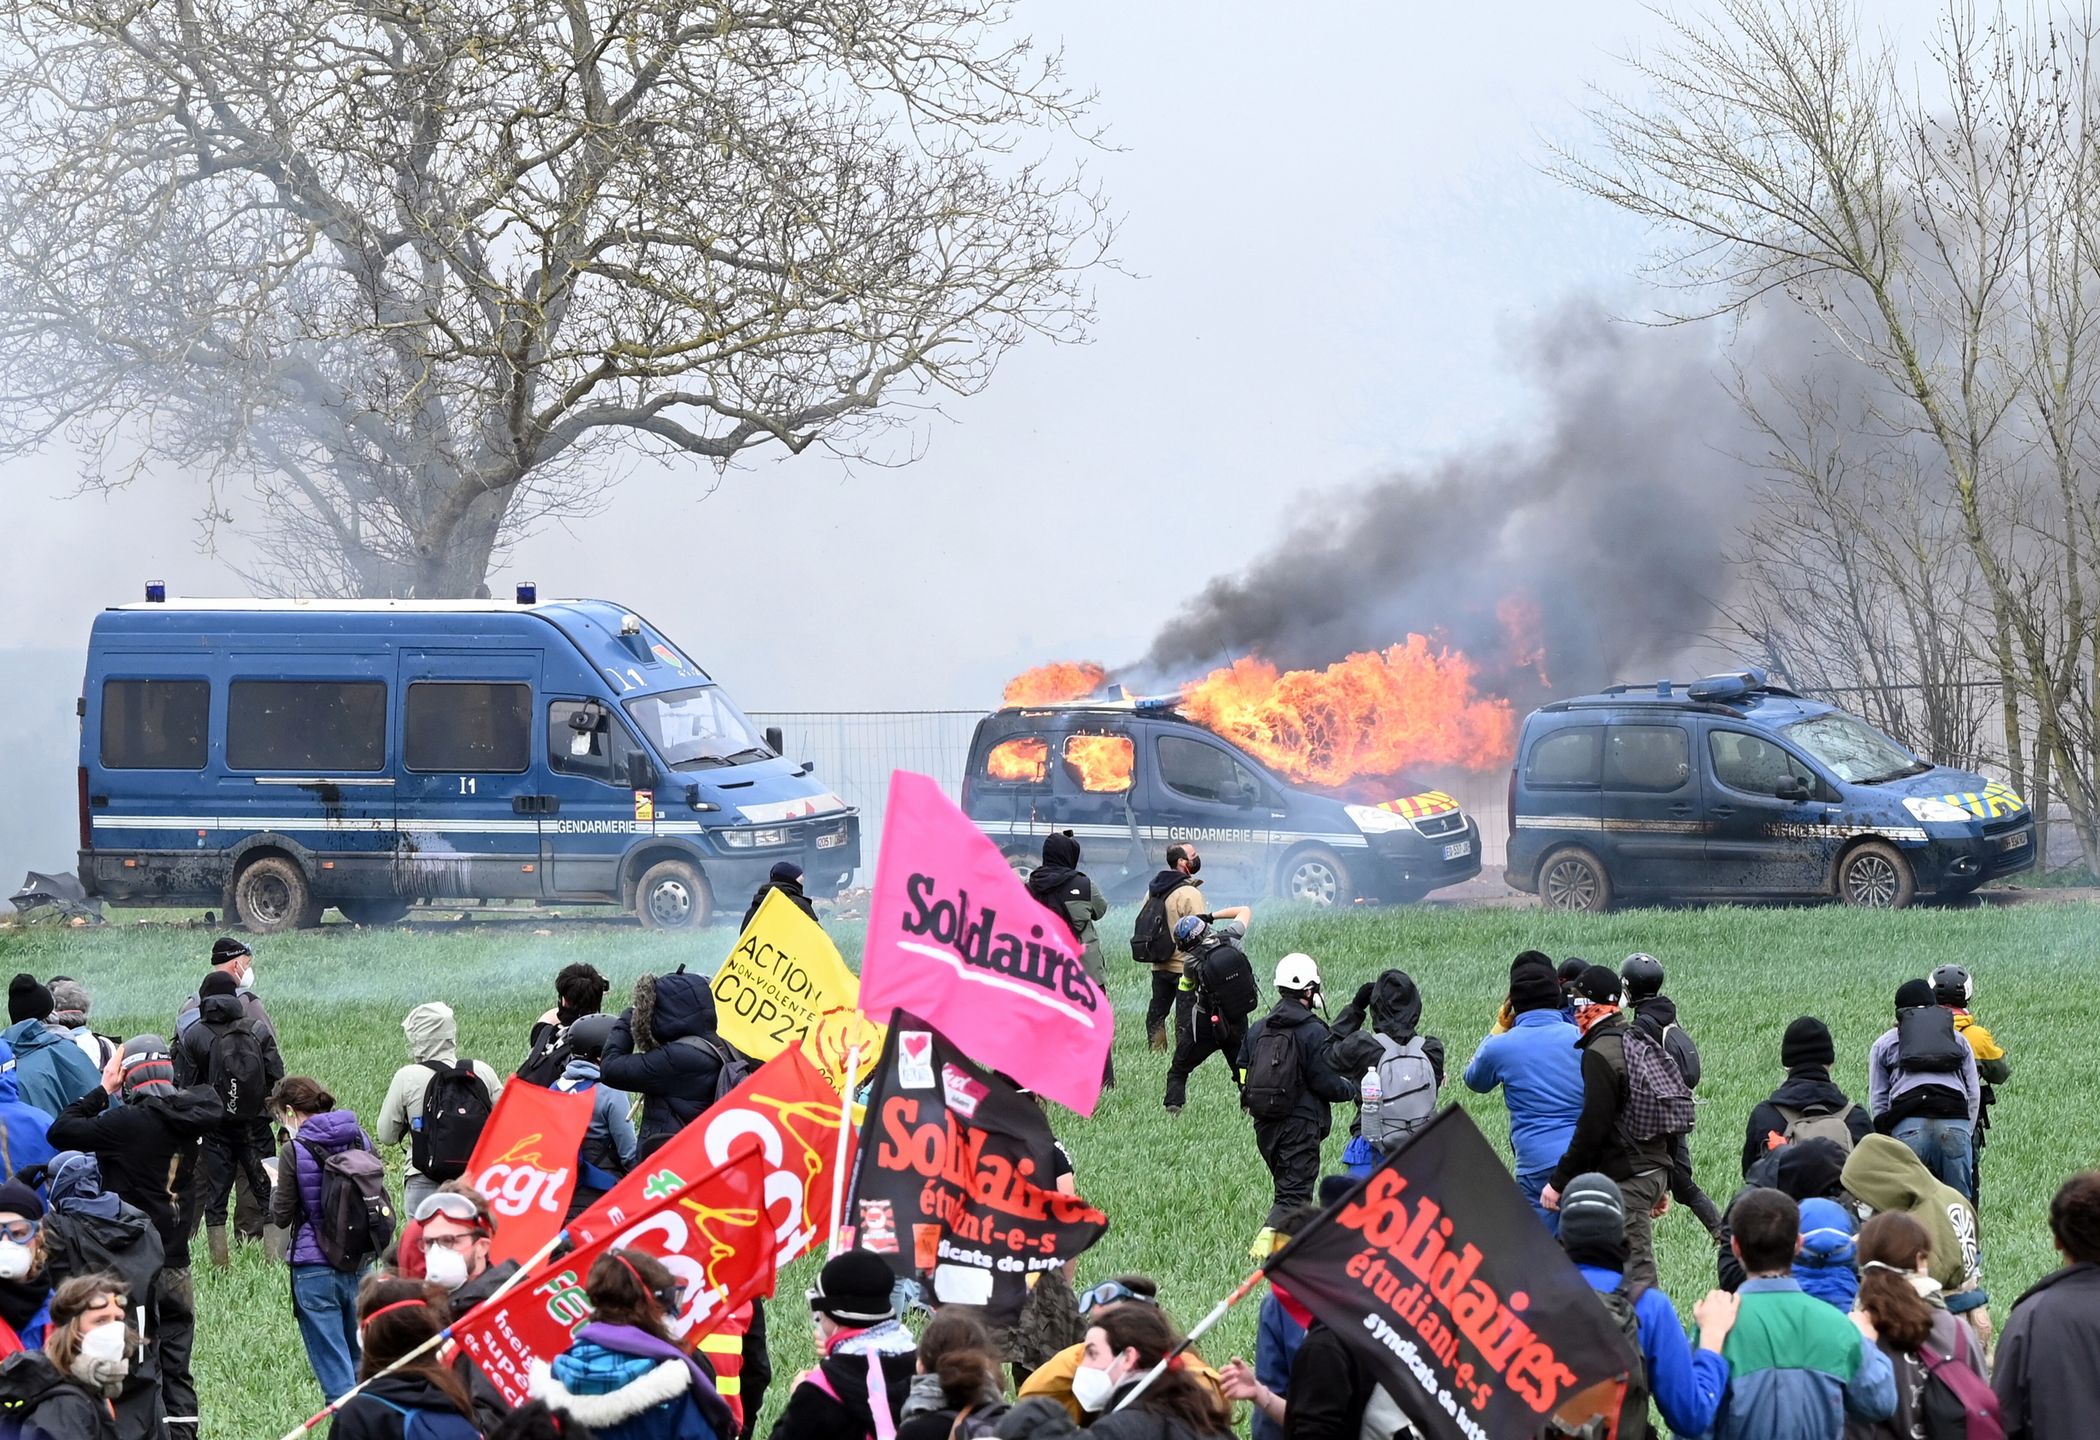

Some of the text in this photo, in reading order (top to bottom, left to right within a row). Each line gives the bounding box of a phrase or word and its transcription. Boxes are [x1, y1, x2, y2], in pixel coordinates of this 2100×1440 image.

[558, 820, 636, 834] GENDARMERIE
[1170, 827, 1251, 842] GENDARMERIE
[902, 872, 1097, 1013] Soldaires
[714, 974, 809, 1049] COP21
[474, 1164, 569, 1217] cgt
[997, 1256, 1025, 1272] de
[1335, 1167, 1578, 1413] Solidaires
[1363, 1313, 1438, 1395] syndicats
